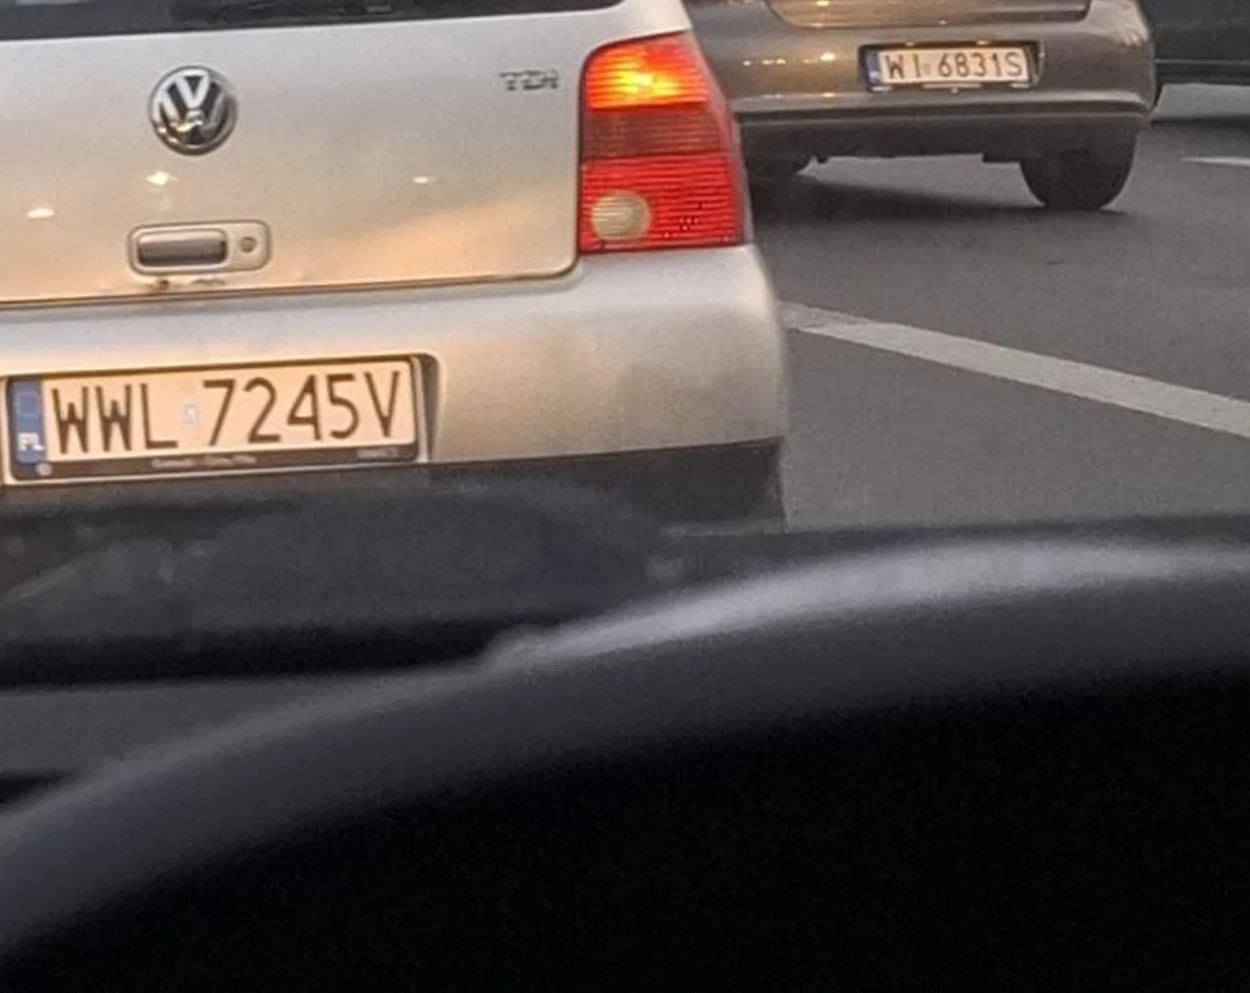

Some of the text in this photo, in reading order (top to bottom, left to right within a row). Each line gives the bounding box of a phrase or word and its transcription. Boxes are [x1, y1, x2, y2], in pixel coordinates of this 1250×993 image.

[886, 52, 1023, 79] WI 6831S
[52, 382, 179, 455] WWL
[202, 370, 402, 447] 7245V
